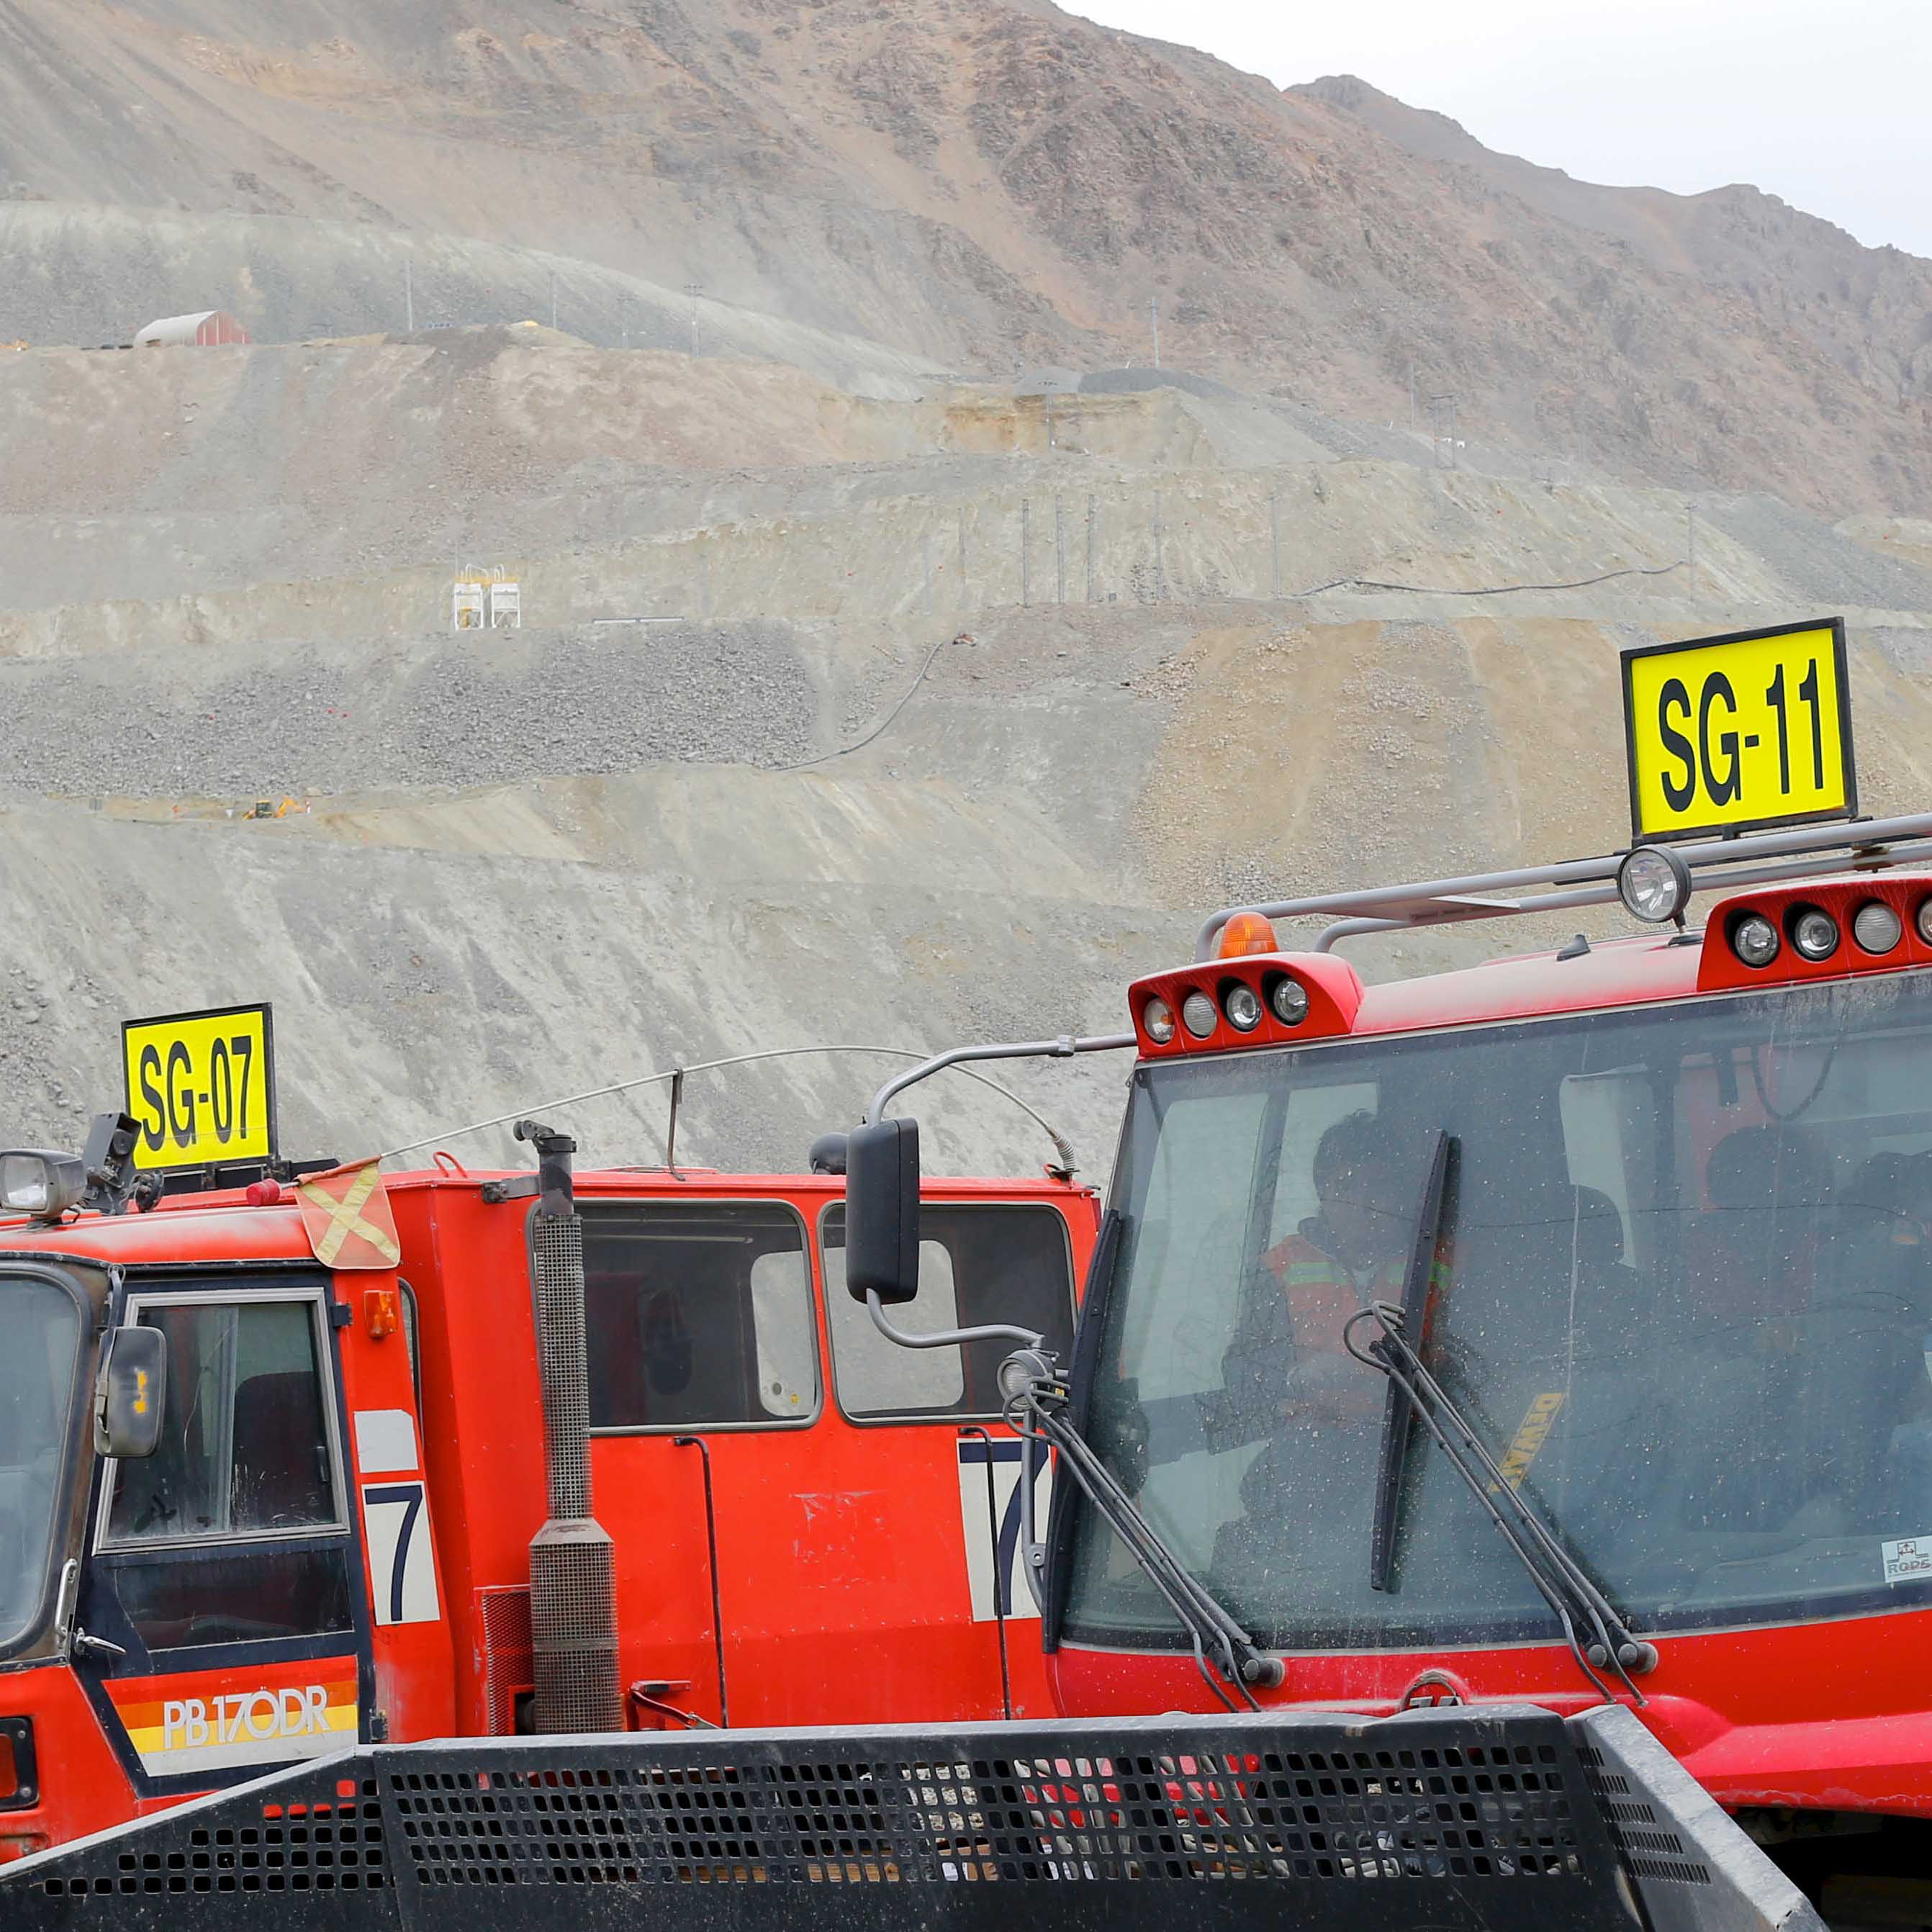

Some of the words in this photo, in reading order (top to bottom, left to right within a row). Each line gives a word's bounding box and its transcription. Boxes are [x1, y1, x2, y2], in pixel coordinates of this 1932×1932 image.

[1658, 658, 1824, 812] SG-11
[140, 1035, 253, 1152] SG-07
[365, 1485, 423, 1622] 7
[959, 1441, 1049, 1616] 7
